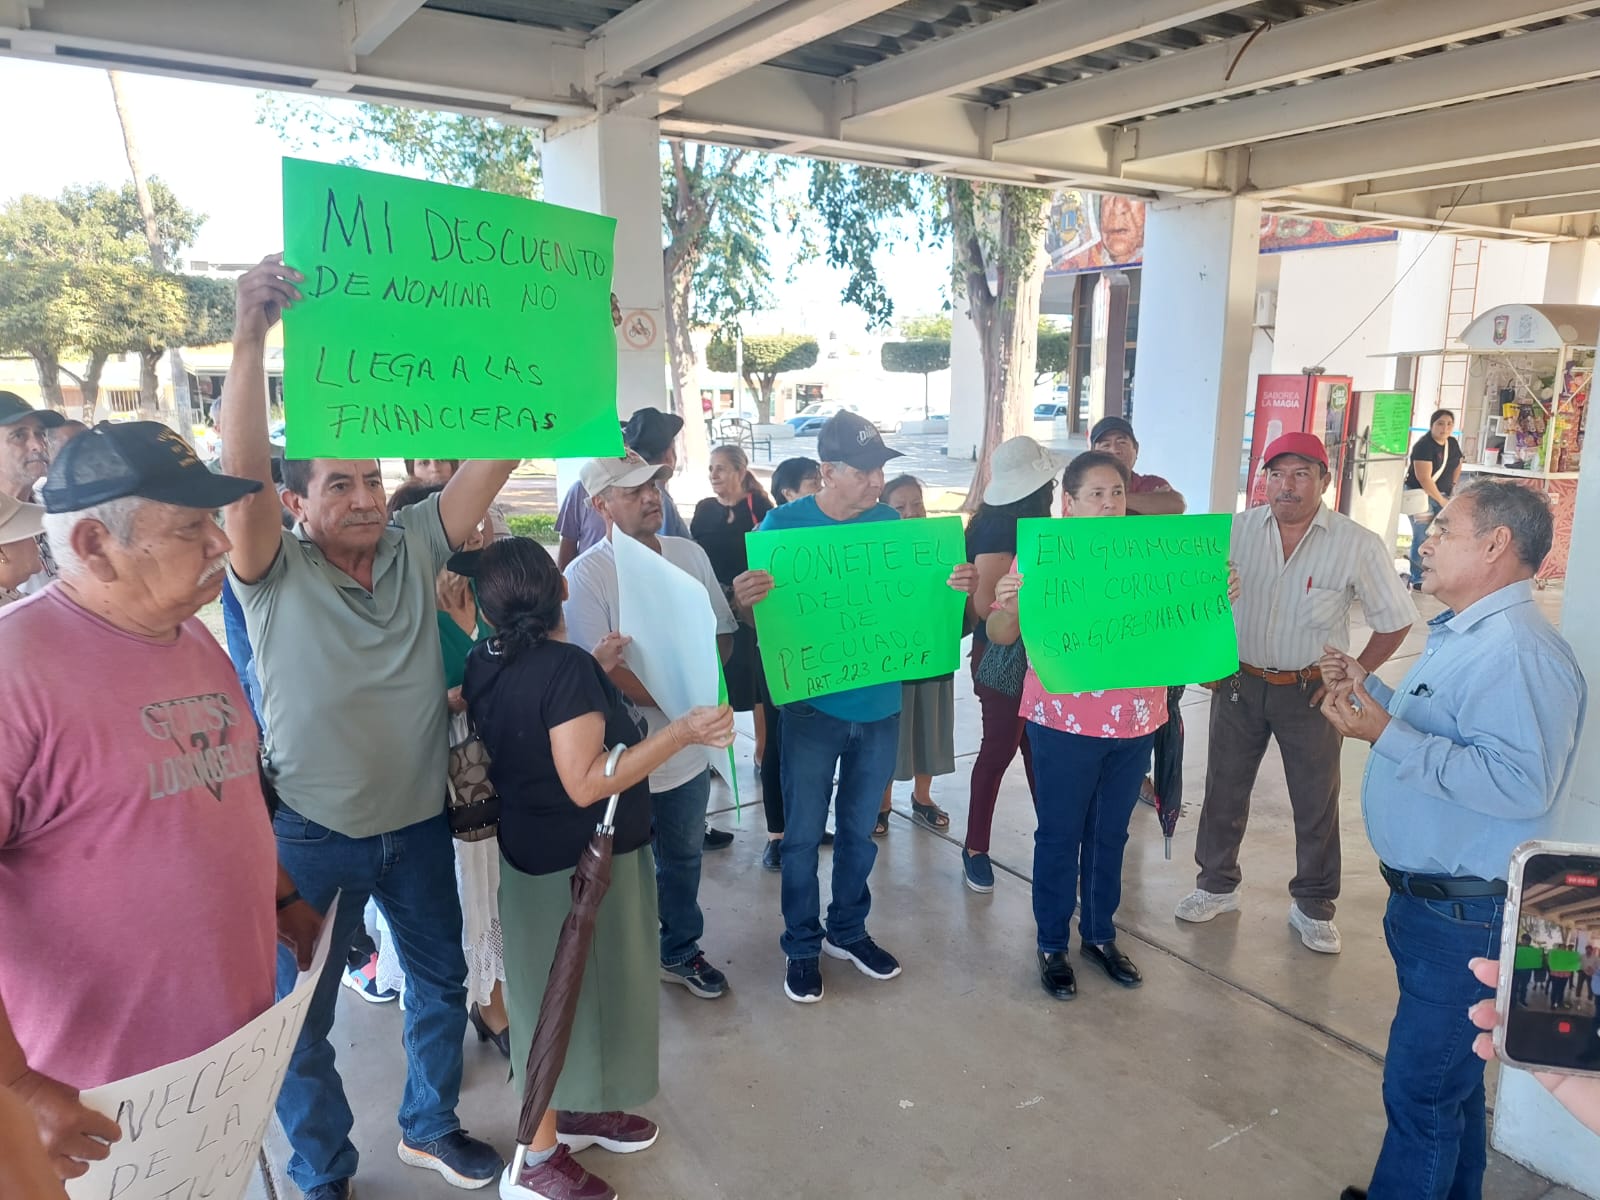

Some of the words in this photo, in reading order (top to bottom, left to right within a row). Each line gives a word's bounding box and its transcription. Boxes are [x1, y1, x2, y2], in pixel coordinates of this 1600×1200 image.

[321, 187, 393, 255] MI
[424, 206, 607, 281] DESCUENTO
[309, 264, 371, 298] DE
[383, 275, 492, 309] NOMINA
[521, 284, 558, 313] NO
[315, 346, 435, 389] LLEGA
[451, 355, 470, 384] A
[485, 355, 544, 386] LAS
[327, 402, 558, 439] FINANCIERAS
[1273, 399, 1300, 408] MAGIA
[769, 539, 903, 589] COMETE
[913, 538, 955, 567] EL
[1037, 533, 1076, 566] EN
[796, 578, 915, 617] DELITO
[1044, 576, 1086, 609] HAY
[1104, 568, 1225, 601] CORRUPCION
[837, 611, 879, 635] DE
[778, 630, 928, 691] PECULADO
[108, 1147, 172, 1200] DE
[195, 1103, 240, 1152] LA
